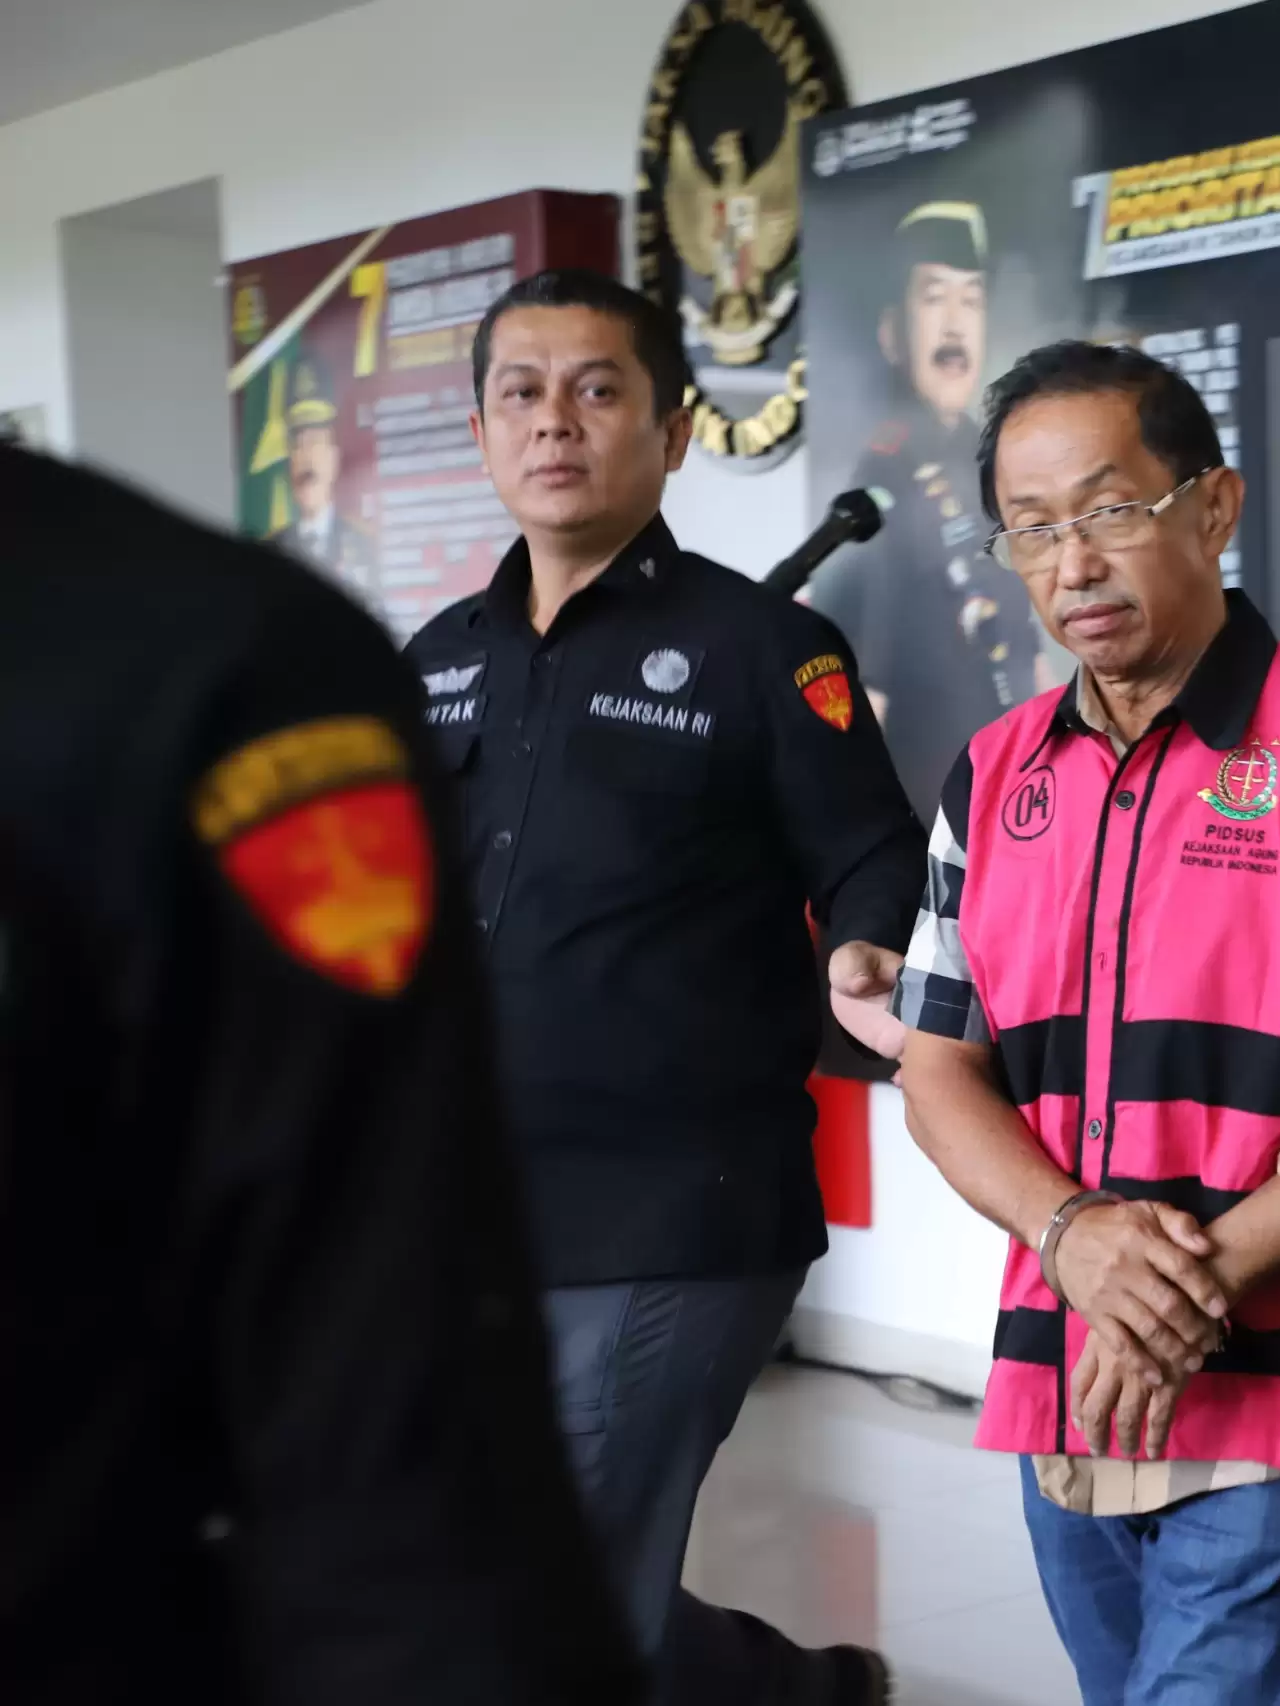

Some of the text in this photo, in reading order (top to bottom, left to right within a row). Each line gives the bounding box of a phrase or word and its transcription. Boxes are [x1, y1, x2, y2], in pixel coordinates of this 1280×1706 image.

[349, 261, 388, 378] 7
[589, 691, 712, 738] KEJAKSAAN RI
[1014, 776, 1050, 828] 04
[1182, 840, 1241, 856] KEJAKSAAN
[1204, 824, 1266, 844] PIDSUS
[1180, 854, 1277, 875] REPUBLIK INDONESIA
